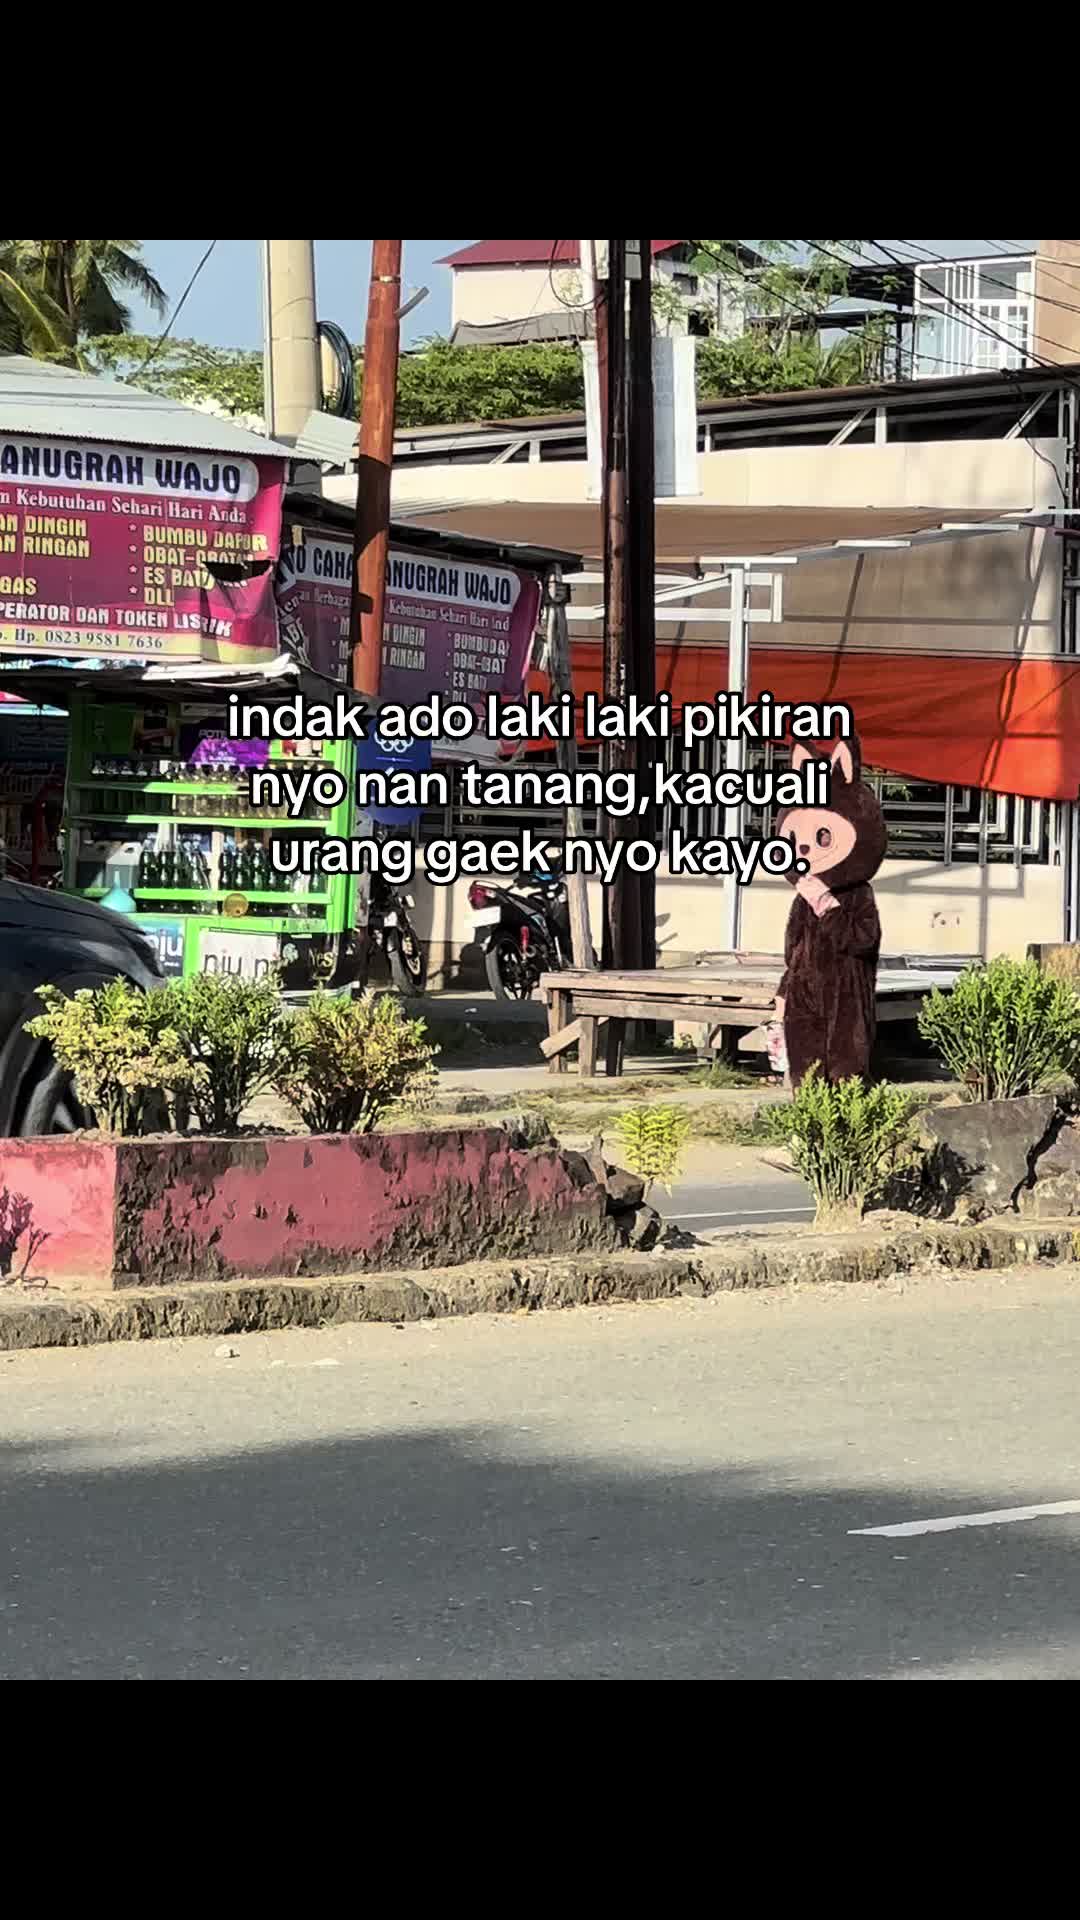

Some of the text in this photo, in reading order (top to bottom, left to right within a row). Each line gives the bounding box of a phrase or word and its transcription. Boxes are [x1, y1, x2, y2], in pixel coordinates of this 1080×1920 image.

[1, 444, 241, 494] ANUGRAH WAJO
[16, 488, 106, 512] Kebutuhan
[111, 496, 162, 517] Sehari
[168, 501, 203, 520] Hari
[25, 515, 87, 537] DINGIN
[143, 525, 207, 547] BUMBU
[24, 536, 90, 558] RINGAN
[0, 576, 37, 596] GAS
[143, 566, 165, 585] ES
[144, 587, 175, 607] DLL
[464, 571, 512, 605] WAJO
[76, 606, 109, 625] DAN
[115, 609, 168, 628] TOKEN
[45, 631, 80, 644] 0823
[87, 633, 120, 646] 9581
[128, 635, 163, 648] 7636
[389, 646, 425, 671] RINGAN
[452, 671, 465, 687] ES
